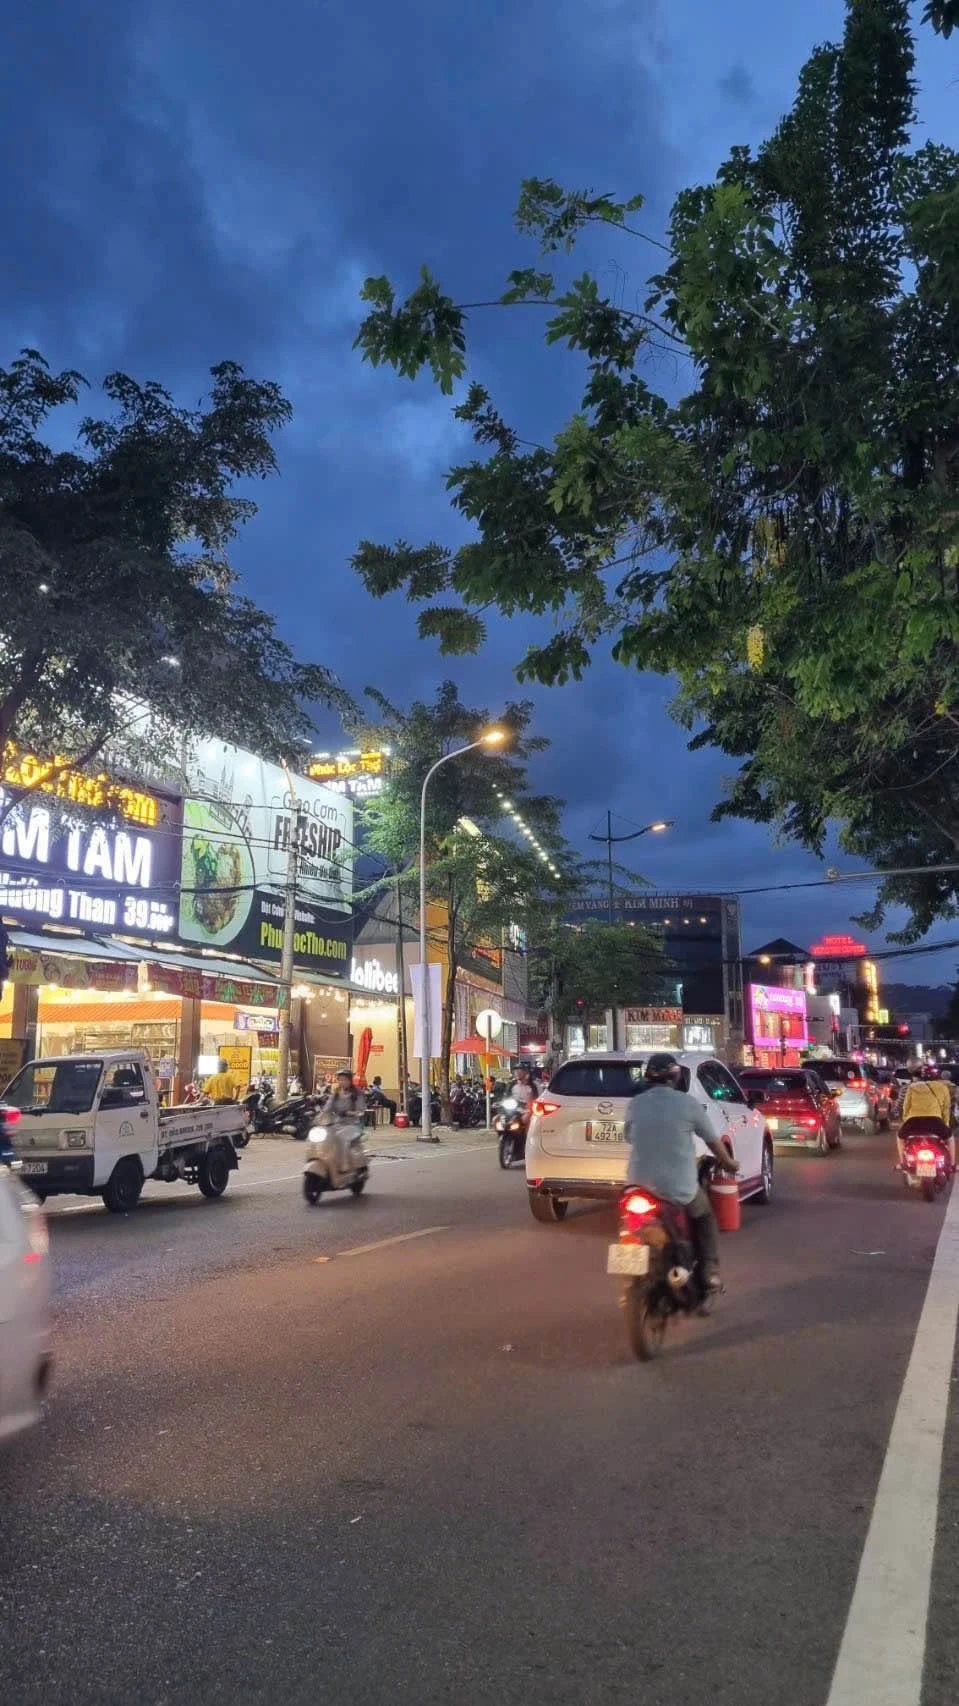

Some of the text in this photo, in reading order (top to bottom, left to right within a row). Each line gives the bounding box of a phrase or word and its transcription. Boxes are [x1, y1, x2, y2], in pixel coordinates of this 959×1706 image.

[69, 890, 116, 925] Than
[649, 897, 679, 909] MINH
[628, 1008, 649, 1022] KIM
